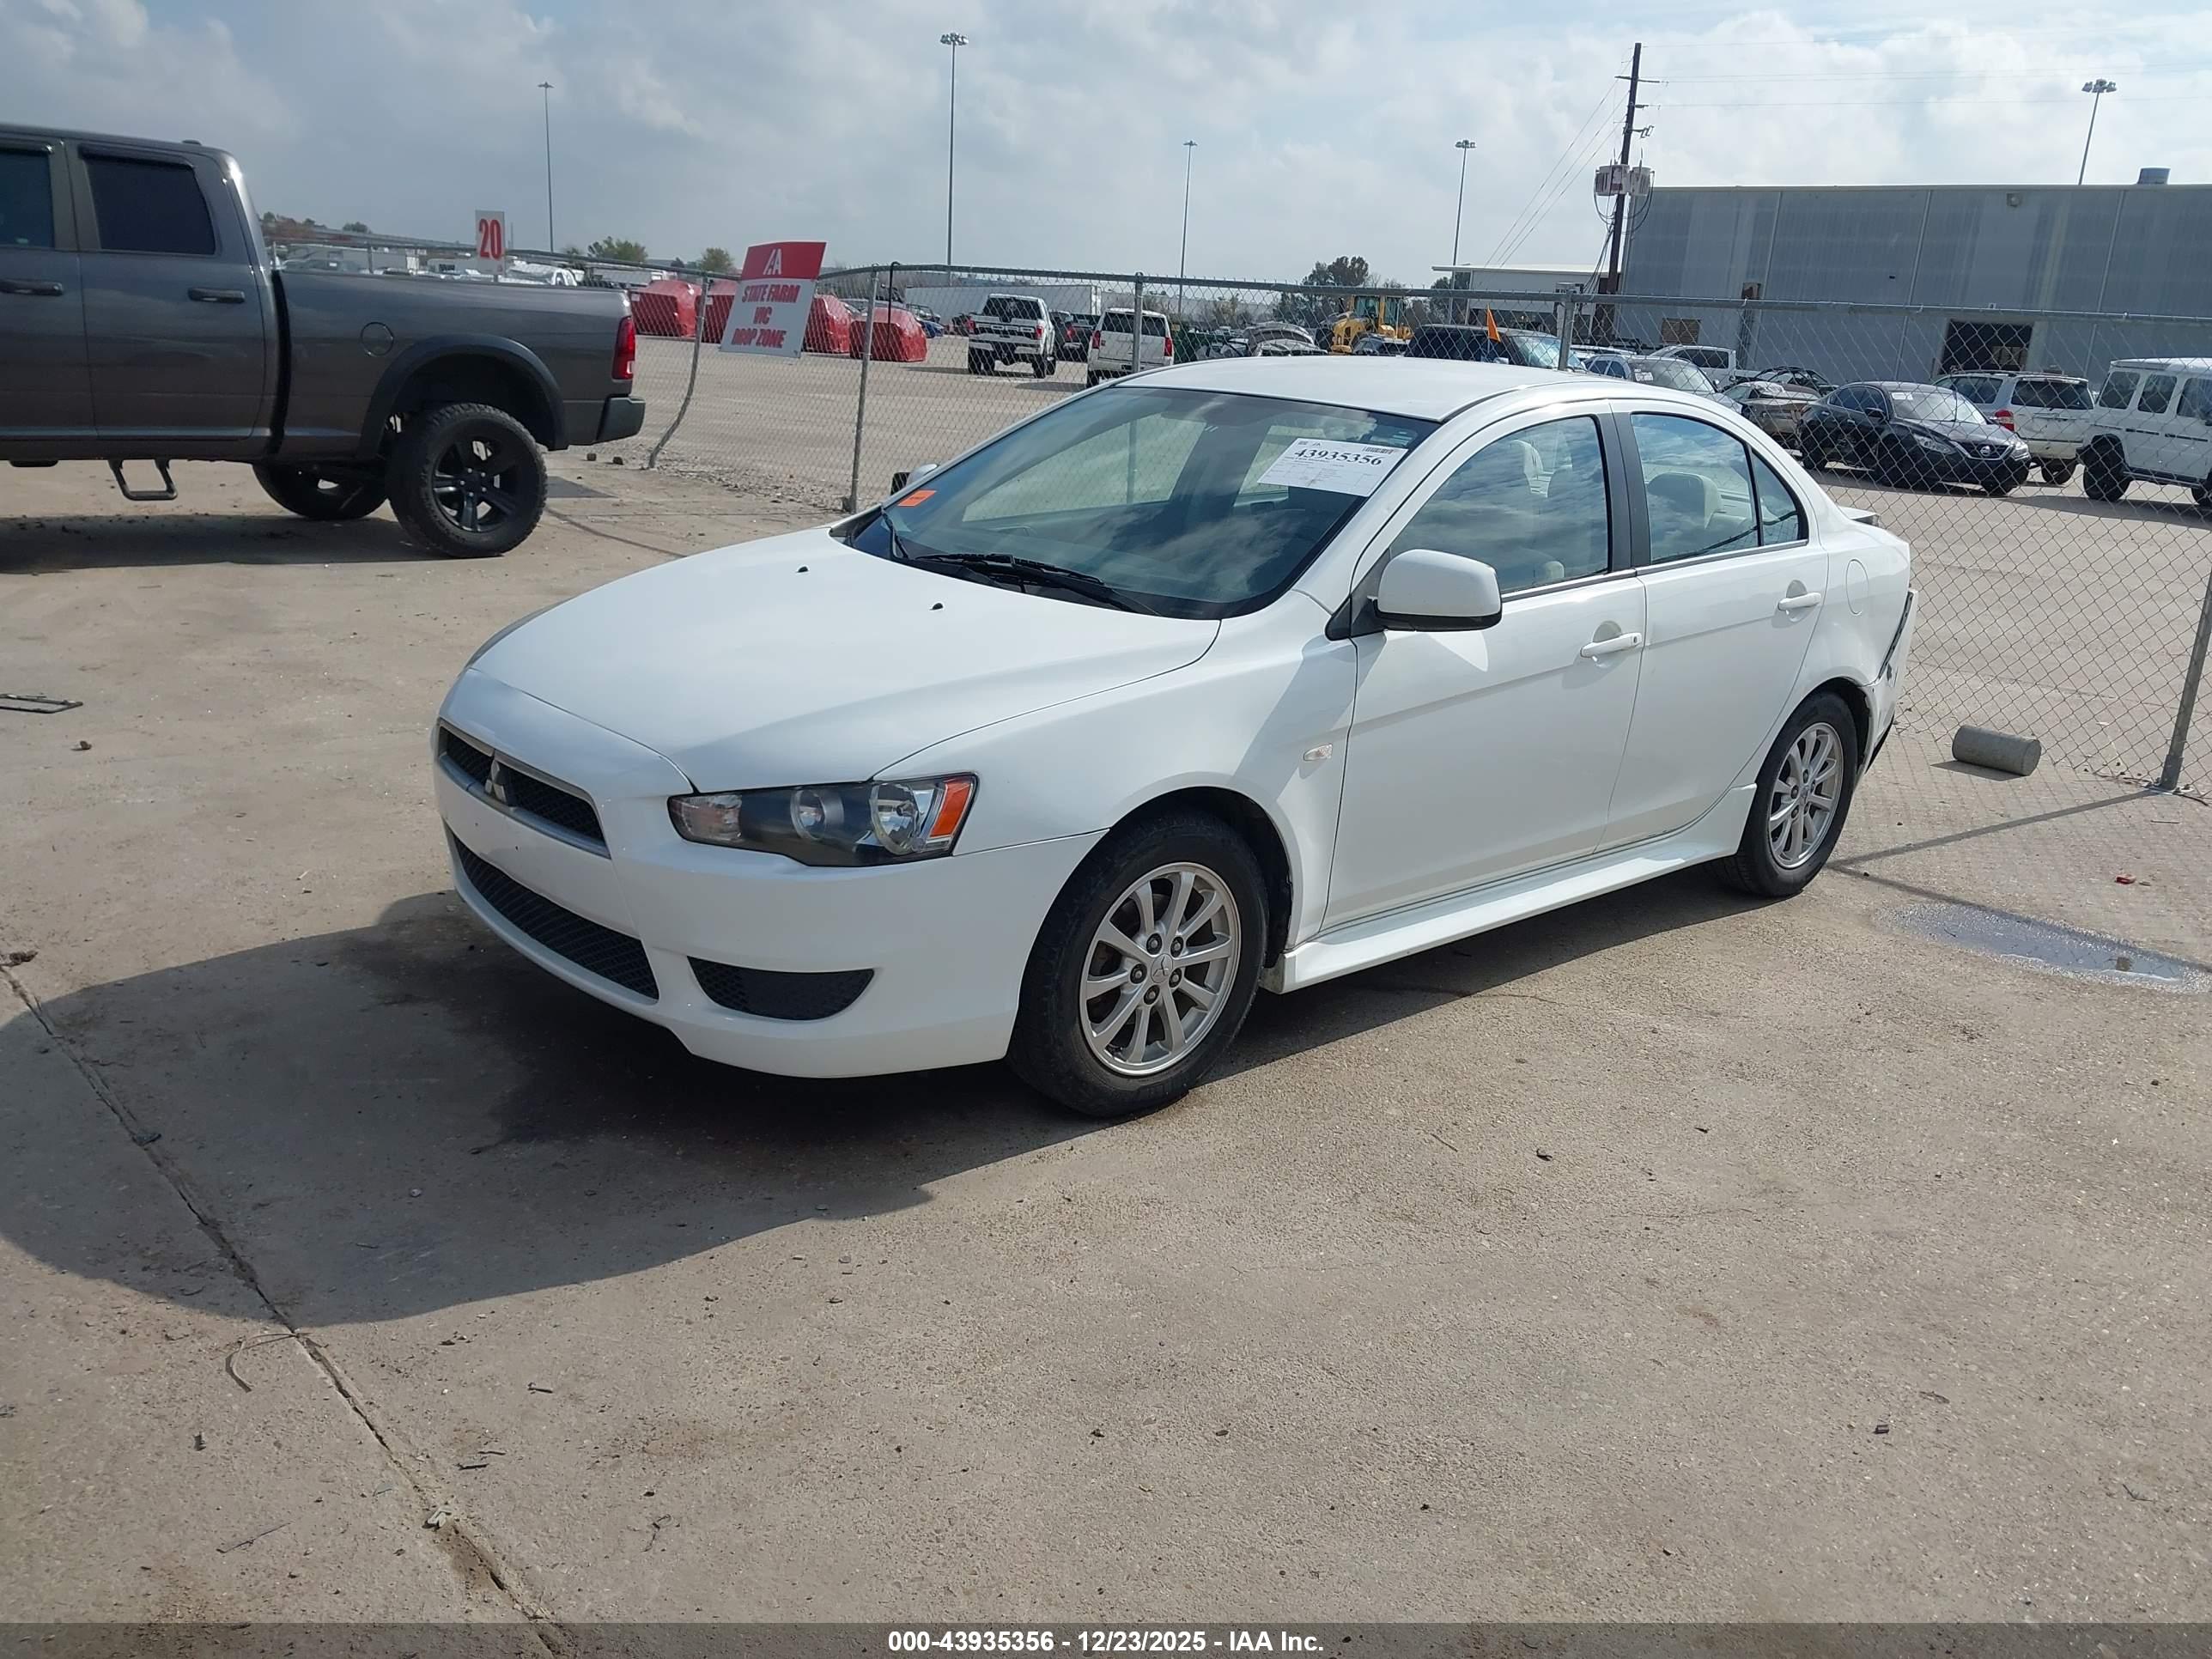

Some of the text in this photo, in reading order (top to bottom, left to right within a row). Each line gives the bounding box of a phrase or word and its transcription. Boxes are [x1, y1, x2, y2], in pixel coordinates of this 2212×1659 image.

[479, 219, 502, 260] 20
[741, 283, 801, 303] STATE FARM
[731, 328, 787, 349] DROP ZONE
[1294, 448, 1385, 466] 43935356
